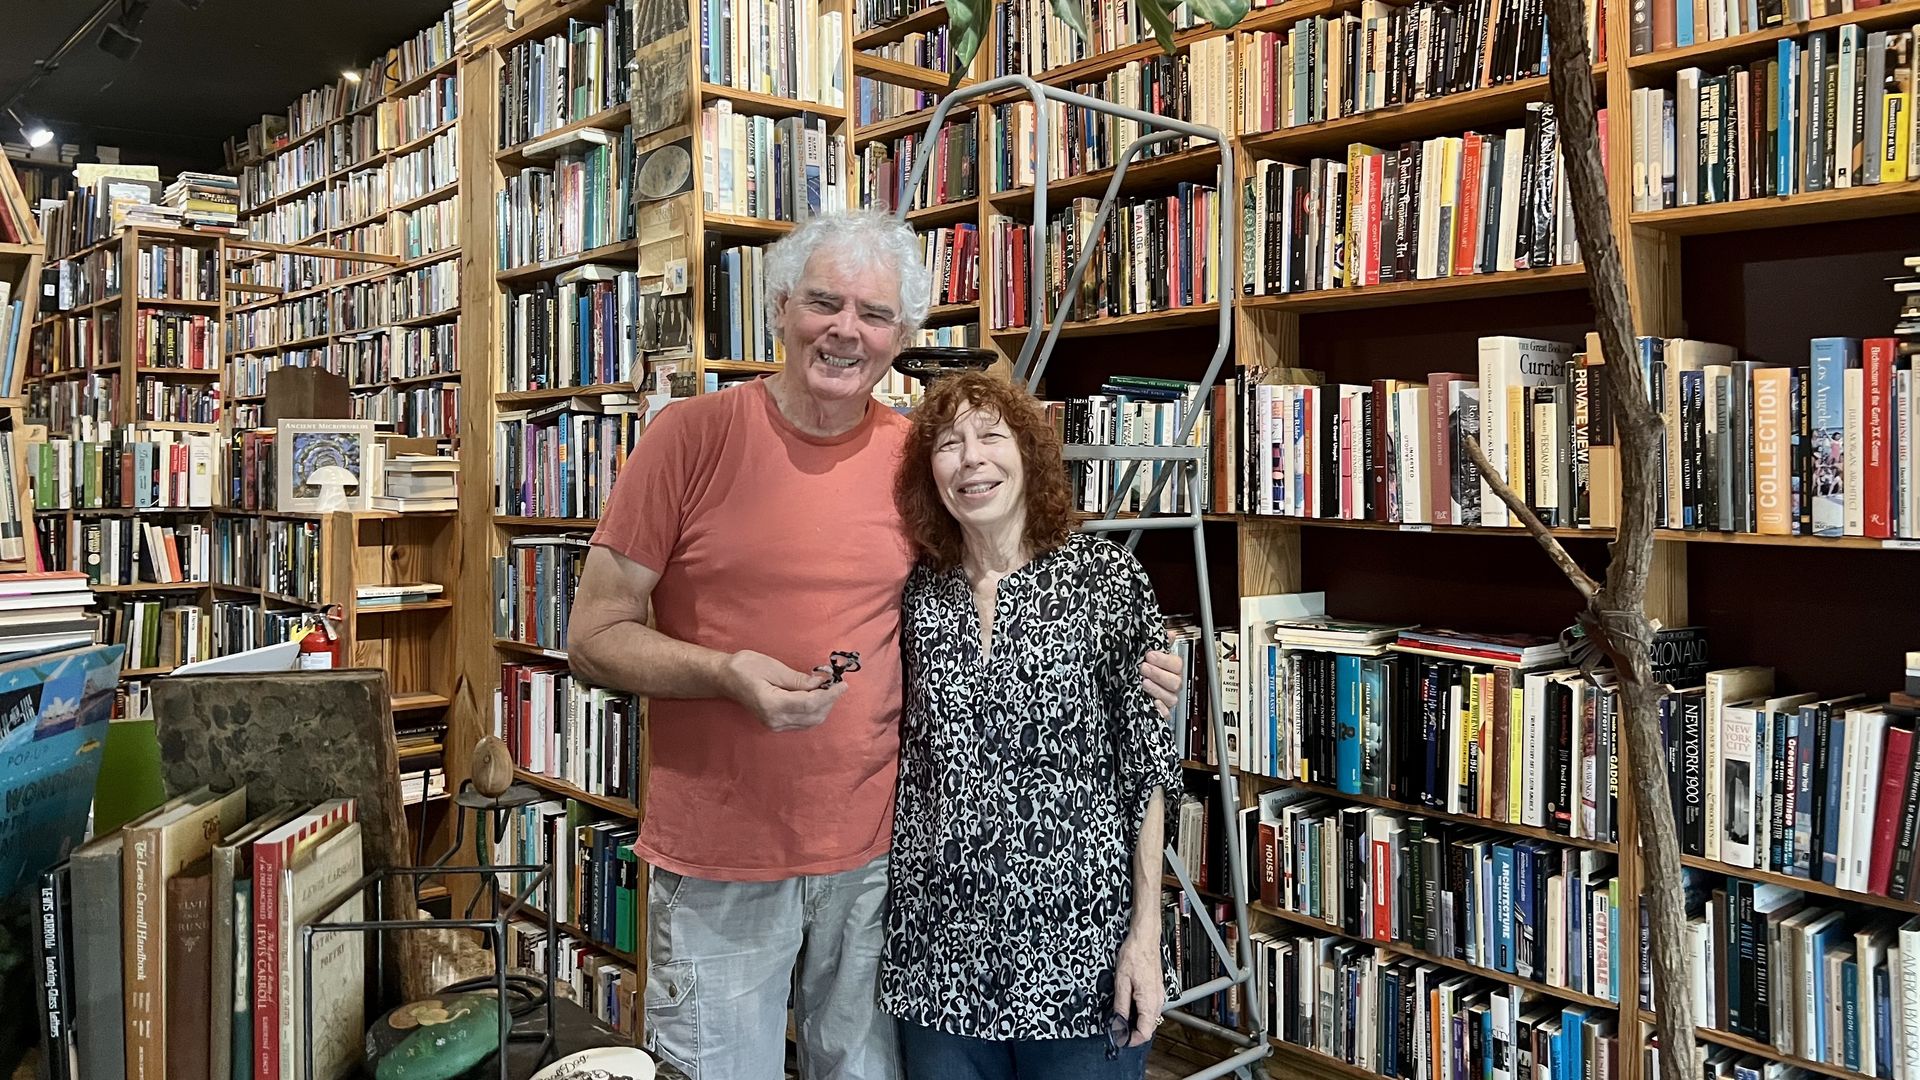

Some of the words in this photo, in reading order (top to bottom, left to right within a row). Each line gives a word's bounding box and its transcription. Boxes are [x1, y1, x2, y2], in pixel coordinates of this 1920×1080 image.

[1701, 101, 1709, 118] GREAT
[1710, 84, 1719, 118] TRANSPORT
[1700, 120, 1708, 134] CITY
[1727, 117, 1737, 139] Decline
[1888, 100, 1896, 137] Domesticity
[1538, 107, 1553, 172] RAVENNA
[1709, 120, 1718, 164] ORGANISATION
[1399, 157, 1412, 193] Northern
[1396, 195, 1410, 240] Renaissance
[1396, 242, 1408, 258] Art
[943, 247, 953, 292] ROOSEVELT
[1530, 342, 1547, 352] Great
[1520, 354, 1565, 376] Currier
[1817, 357, 1830, 379] Los
[1872, 347, 1880, 385] Architecture
[1576, 370, 1588, 424] PRIVATE
[1717, 386, 1725, 434] PALLADIO
[1816, 382, 1830, 431] Angeles
[1870, 407, 1880, 425] Early
[1541, 434, 1549, 458] PERSIAN
[1577, 427, 1589, 462] VIEW
[1759, 380, 1777, 507] COLLECTION
[1870, 440, 1880, 466] Century
[1541, 461, 1549, 477] ART
[1685, 704, 1698, 738] NEW
[1727, 724, 1751, 733] NEW
[1725, 733, 1751, 743] YORK
[1727, 742, 1749, 752] CITY
[1685, 740, 1698, 775] YORK
[1786, 740, 1796, 790] Greenwich
[1686, 776, 1699, 803] 1900
[1910, 772, 1920, 801] Different,
[1785, 792, 1795, 826] Village
[1902, 814, 1914, 847] Appealing
[135, 841, 147, 859] The
[137, 860, 145, 891] Lewis
[594, 888, 599, 896] OF
[42, 888, 53, 910] LEWIS
[137, 893, 145, 928] Carroll
[1426, 880, 1436, 912] Architects
[44, 914, 55, 949] CARROLL
[258, 924, 266, 956] LEWIS
[1427, 928, 1437, 940] City
[1596, 913, 1607, 945] CITY
[1741, 924, 1753, 960] AVENUE
[137, 930, 145, 980] Handbook
[1597, 950, 1608, 985] SALE
[1757, 943, 1766, 964] LOUIS
[45, 956, 58, 1009] Looking-Glass
[258, 960, 266, 1010] CARROLL
[1757, 968, 1766, 1002] SULLIVAN
[1903, 953, 1917, 1005] AMERICA
[49, 1011, 61, 1037] Letters
[1904, 1008, 1917, 1022] BY
[1905, 1024, 1918, 1066] DESIGN
